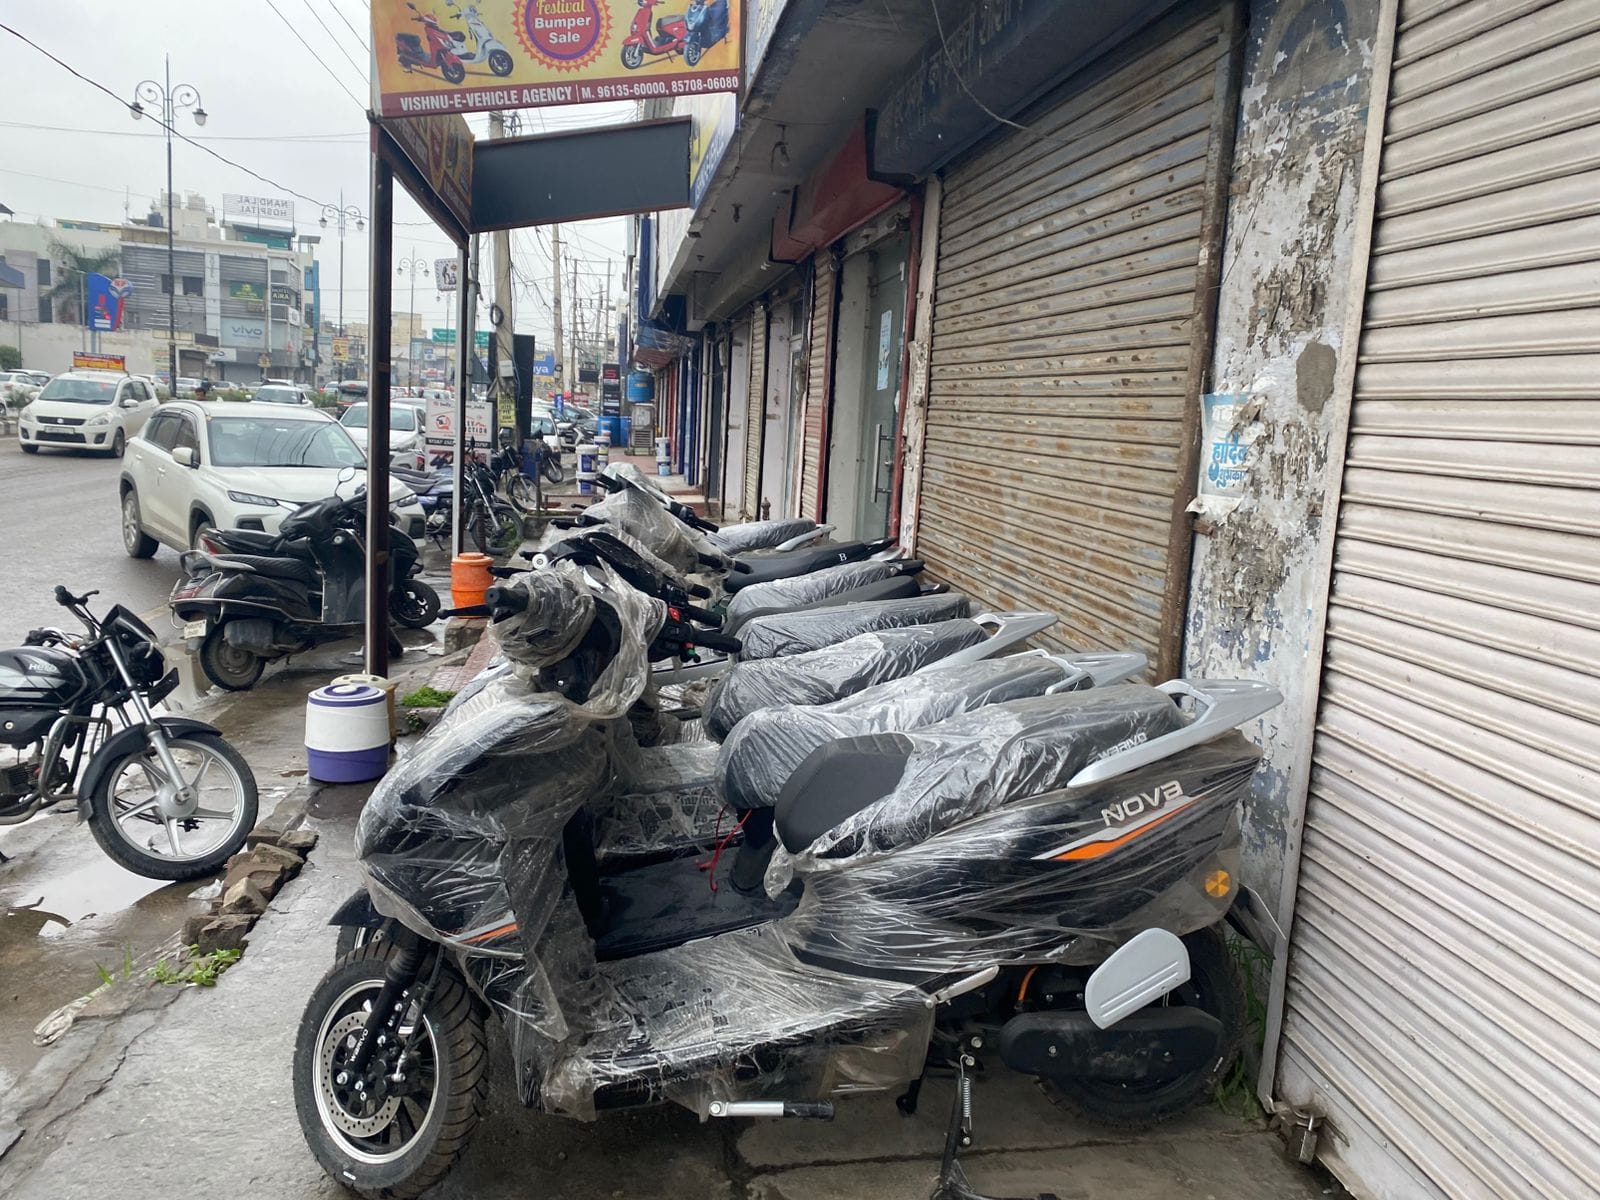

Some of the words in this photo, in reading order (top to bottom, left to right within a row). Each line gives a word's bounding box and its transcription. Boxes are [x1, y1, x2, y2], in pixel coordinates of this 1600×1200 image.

[536, 0, 585, 15] Festival
[534, 16, 591, 29] Bumper
[548, 31, 580, 43] Sale
[400, 90, 519, 111] VISHNU-E-VEHICLE
[522, 86, 572, 103] AGENCY
[581, 87, 595, 99] M.
[597, 81, 669, 98] 96135-60000,
[671, 76, 739, 93] 85708-06080
[231, 325, 263, 336] vivo
